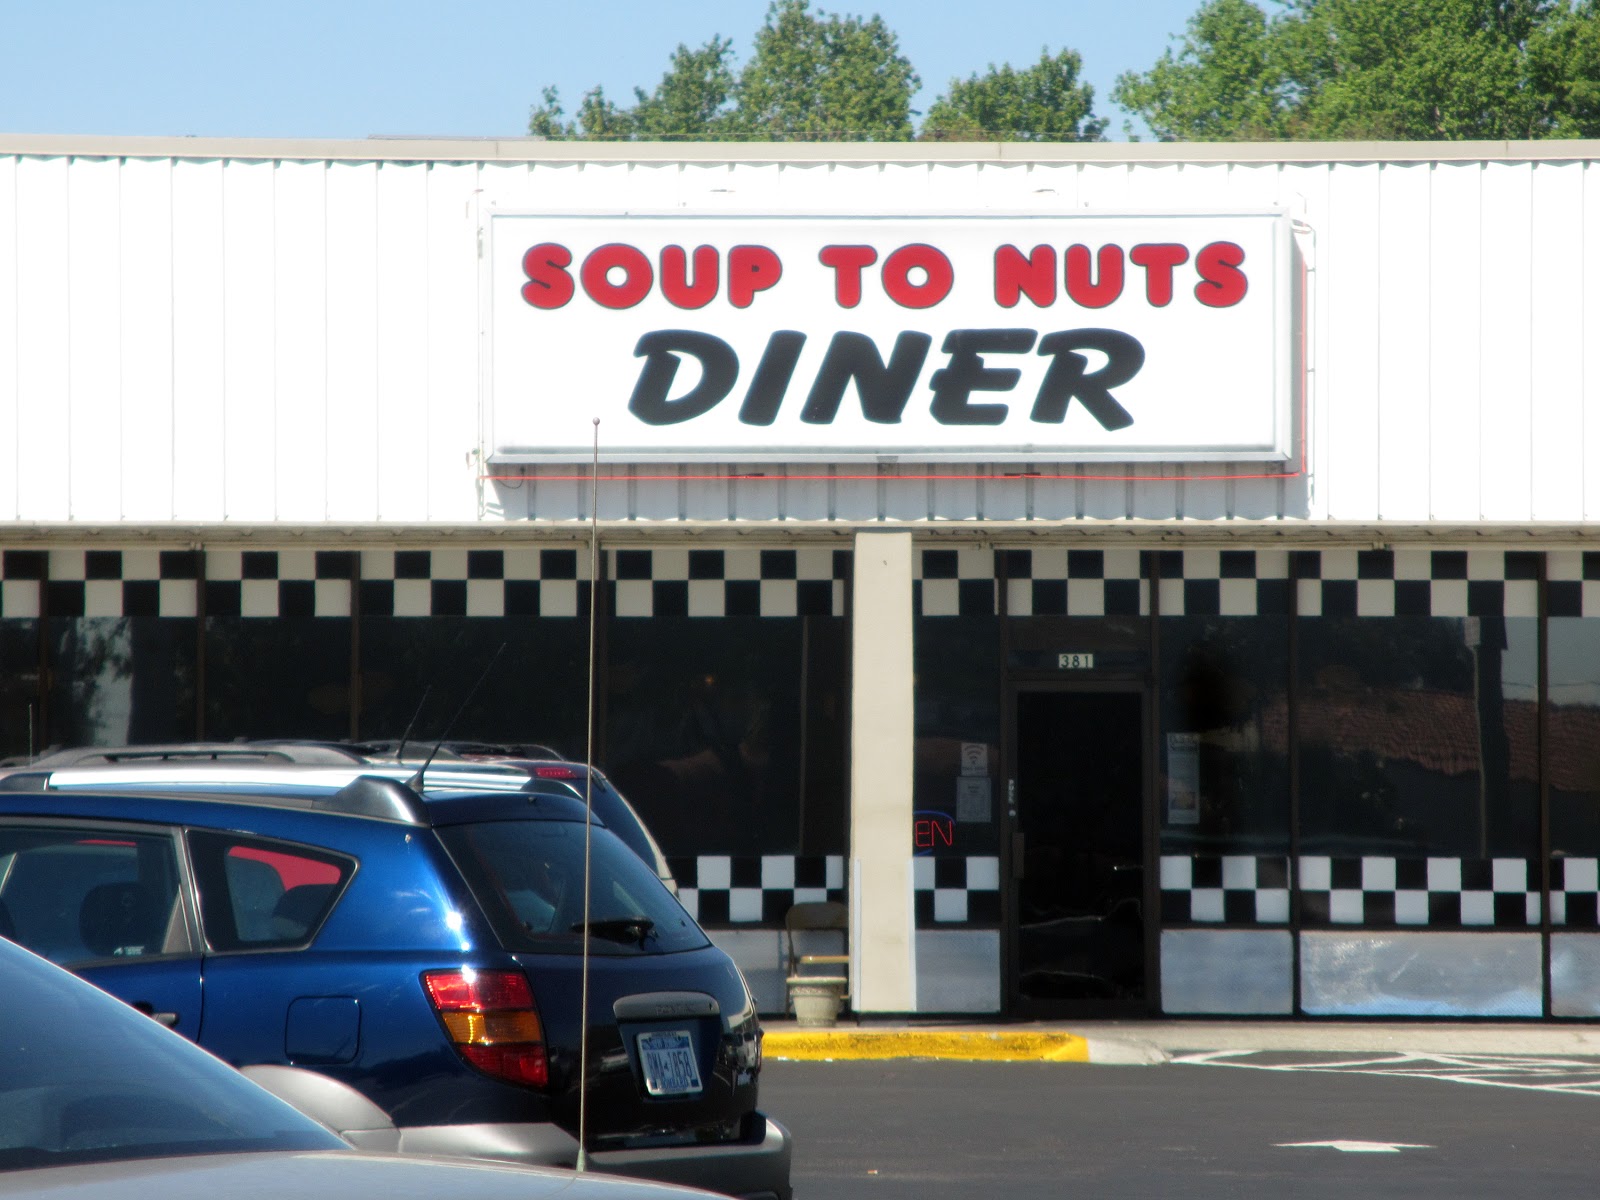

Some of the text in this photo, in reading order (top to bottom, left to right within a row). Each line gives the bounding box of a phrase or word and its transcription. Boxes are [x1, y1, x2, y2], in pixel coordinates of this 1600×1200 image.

[522, 241, 1248, 310] SOUP TO NUTS
[629, 328, 1145, 431] DINER
[1060, 654, 1090, 669] 381
[915, 820, 953, 847] EN
